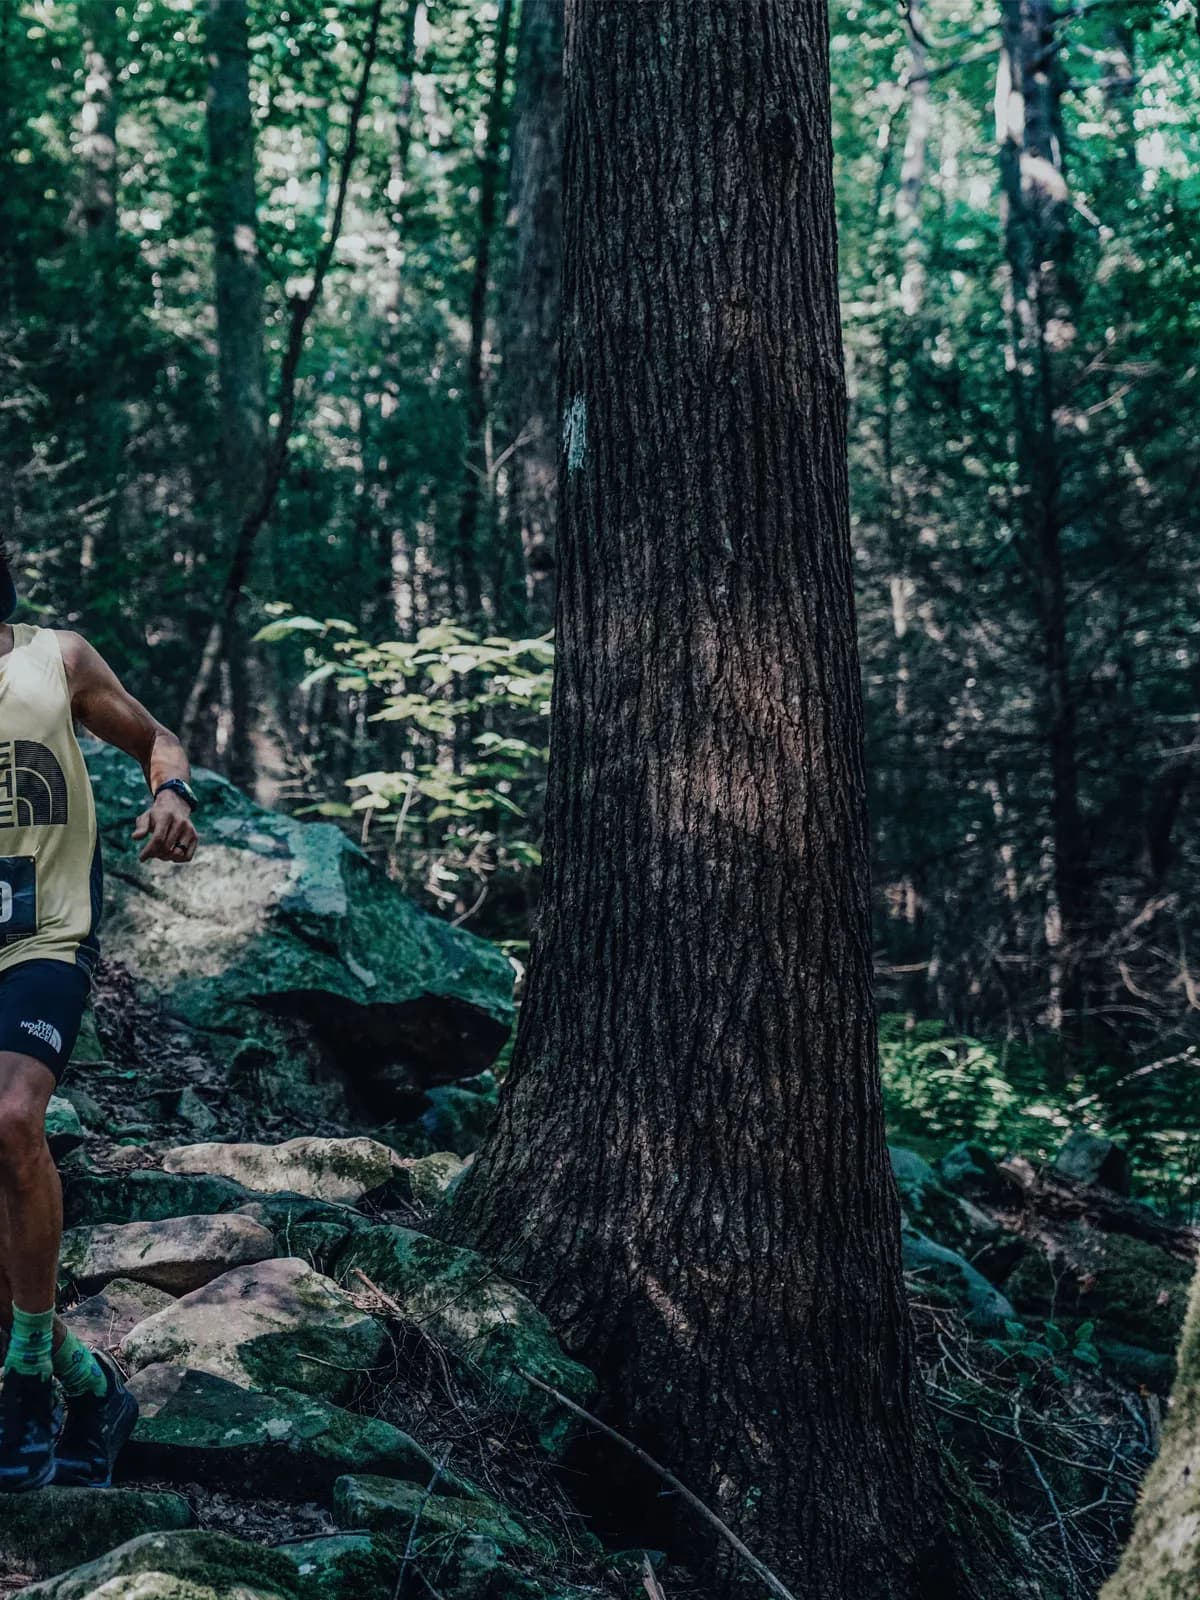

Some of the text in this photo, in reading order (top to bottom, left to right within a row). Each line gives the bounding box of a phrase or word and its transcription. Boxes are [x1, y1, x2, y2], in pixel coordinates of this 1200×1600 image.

[20, 1021, 51, 1036] NORTH
[37, 1019, 54, 1031] THE
[28, 1028, 50, 1042] FACE
